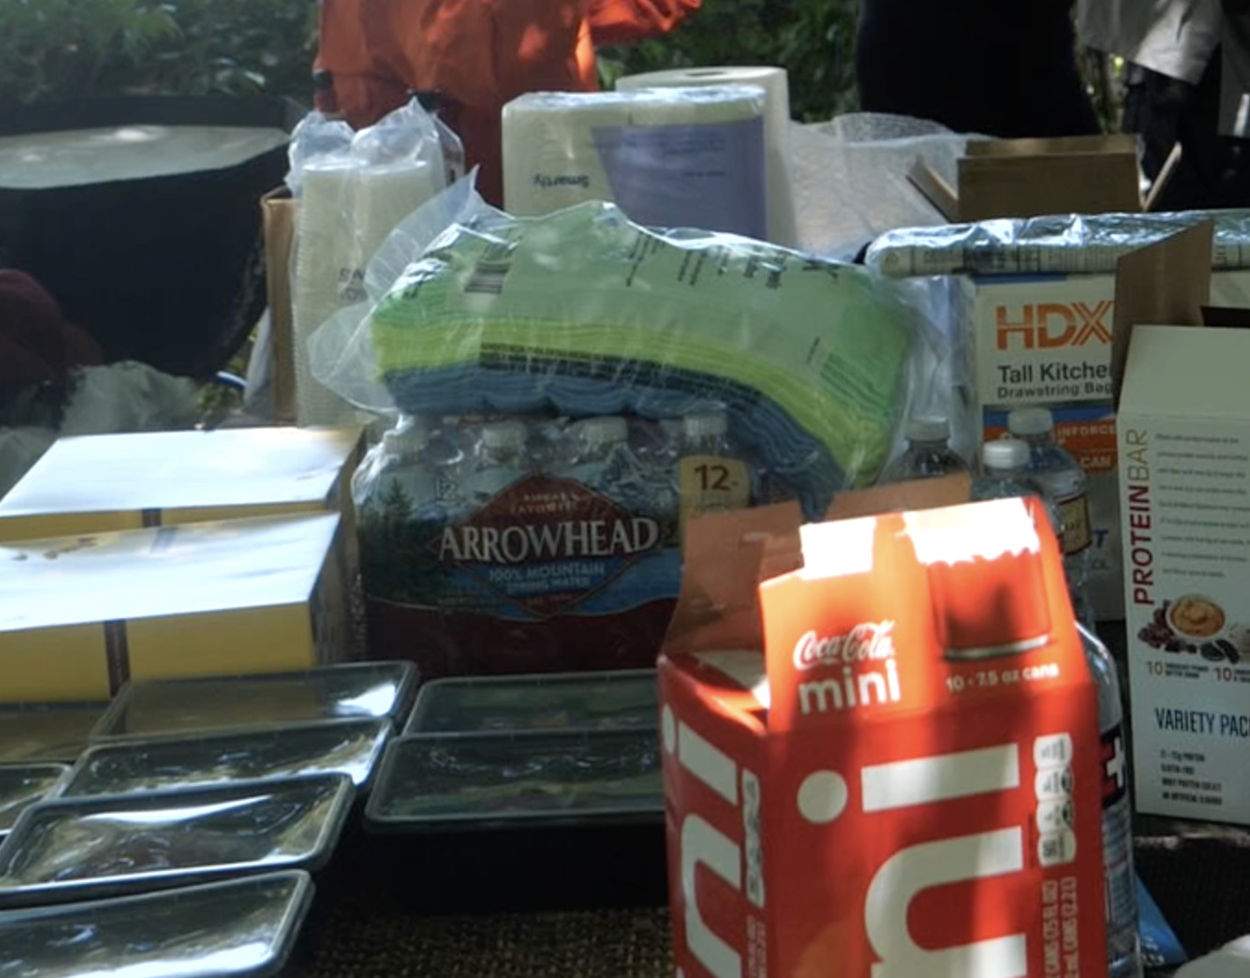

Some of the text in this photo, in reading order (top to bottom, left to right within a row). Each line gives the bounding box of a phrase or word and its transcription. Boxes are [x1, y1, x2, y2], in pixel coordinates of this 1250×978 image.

[996, 300, 1114, 351] HDX
[998, 360, 1112, 384] Tall Kitche
[998, 380, 1113, 400] Drawstring Bag
[1057, 424, 1117, 438] INFORCE
[438, 517, 660, 564] ARROWHEAD
[792, 619, 897, 671] Coca-Cola
[1022, 663, 1060, 682] cans
[1214, 667, 1232, 682] 10
[799, 658, 901, 715] mini
[1154, 707, 1216, 734] VARIETY
